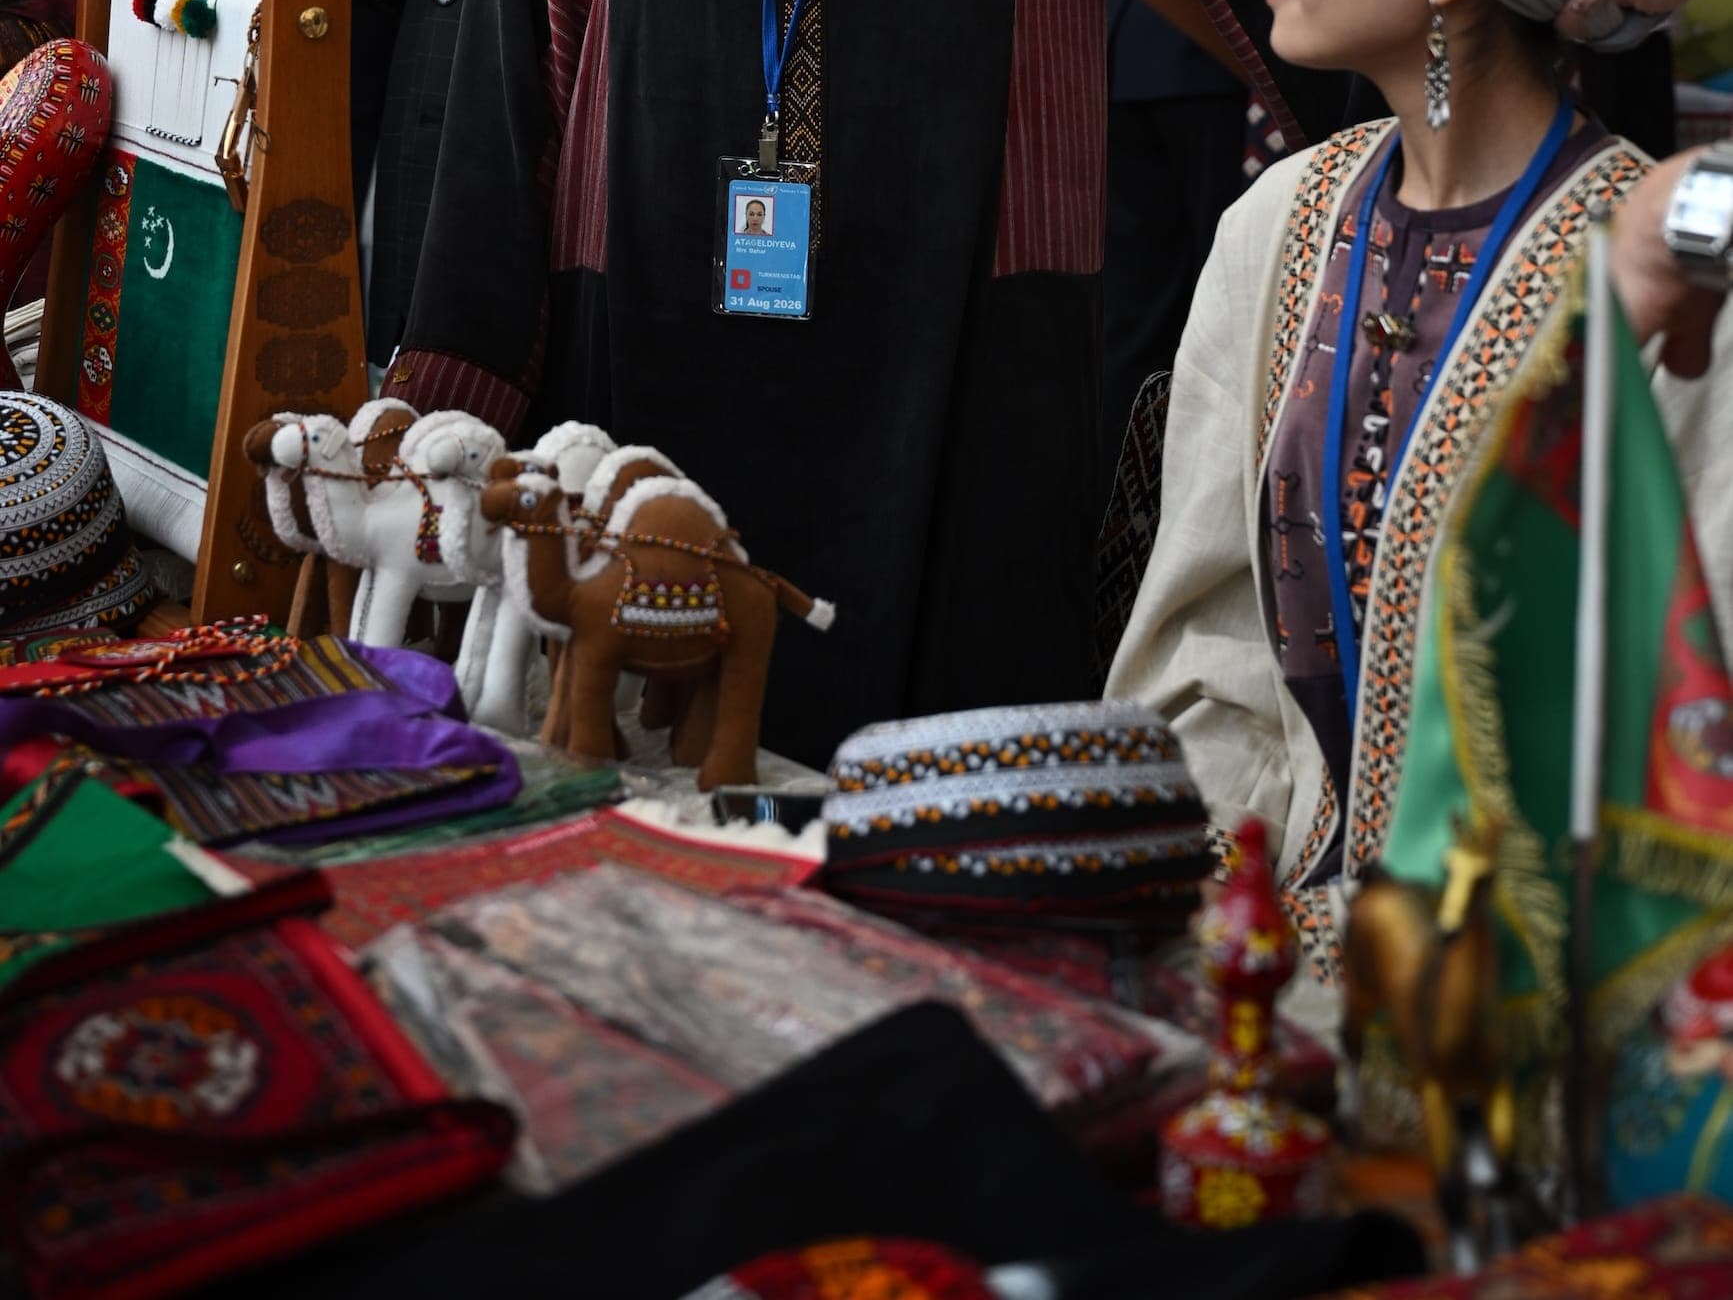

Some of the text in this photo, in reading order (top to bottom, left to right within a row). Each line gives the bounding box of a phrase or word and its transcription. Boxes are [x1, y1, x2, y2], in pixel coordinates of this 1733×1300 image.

[734, 238, 797, 250] ATAGELDIYEVA
[730, 296, 802, 310] 31 Aug 2026
